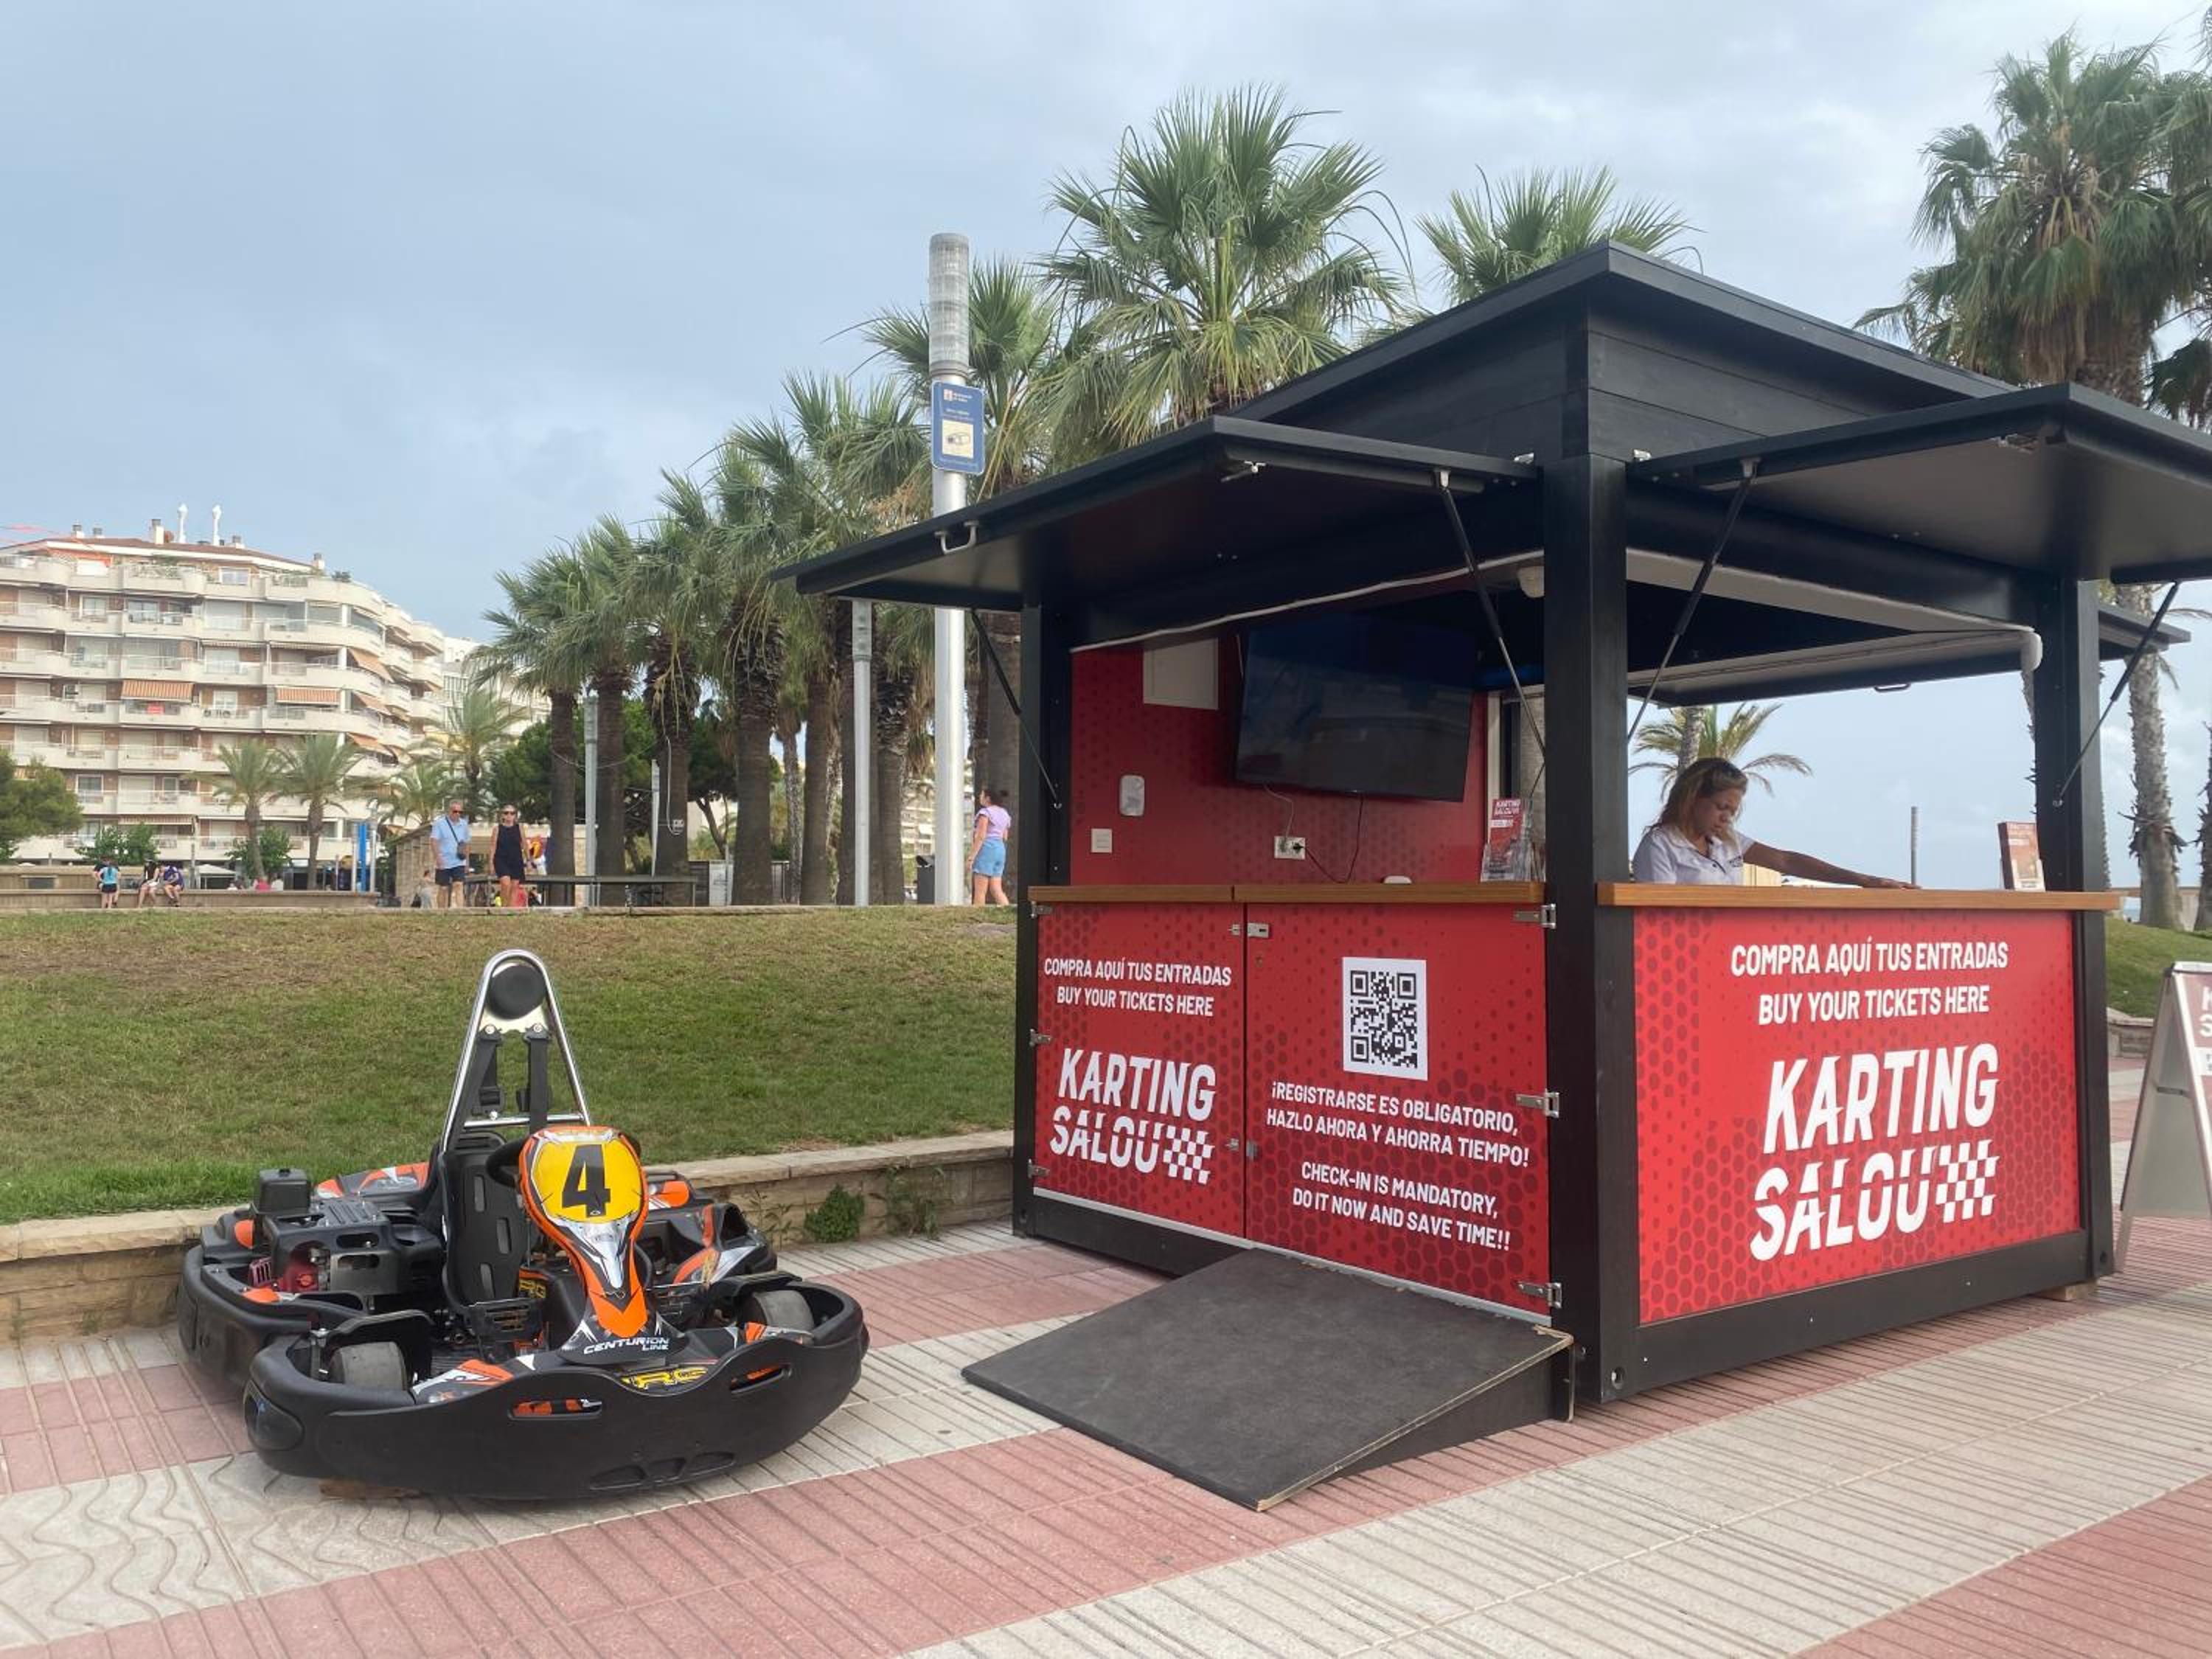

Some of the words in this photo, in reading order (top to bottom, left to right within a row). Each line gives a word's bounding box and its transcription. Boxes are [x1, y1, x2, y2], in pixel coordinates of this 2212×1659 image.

[1044, 958, 1092, 978] COMPRA
[1095, 957, 1125, 981] AQUÍ
[1127, 961, 1152, 982] TUS
[1155, 963, 1232, 987] ENTRADAS
[1731, 943, 1821, 977] COMPRA
[1824, 936, 1872, 977] AQUÍ
[1875, 942, 1912, 972] TUS
[1915, 941, 2008, 971] ENTRADAS
[1057, 986, 1082, 1005] BUY
[1084, 987, 1117, 1008] YOUR
[1119, 990, 1175, 1013] TICKETS
[1176, 995, 1214, 1017] HERE
[1759, 992, 1803, 1026] BUY
[1807, 990, 1860, 1022] YOUR
[1864, 987, 1941, 1018] TICKETS
[1944, 984, 1990, 1014] HERE
[1058, 1048, 1216, 1121] KARTING
[1272, 1081, 1377, 1115] ¡REGISTRARSE
[1378, 1095, 1400, 1116] ES
[1402, 1099, 1518, 1136] OBLIGATORIO,
[1763, 1043, 2000, 1154] KARTING
[1049, 1105, 1165, 1174] SALOU
[1266, 1108, 1313, 1133] HAZLO
[1315, 1116, 1368, 1141] AHORA
[1371, 1123, 1382, 1143] Y
[1384, 1126, 1453, 1155] AHORRA
[1458, 1136, 1529, 1168] TIEMPO!
[563, 1144, 611, 1217] 4
[1301, 1161, 1371, 1192] CHECK-IN
[1374, 1174, 1390, 1195] IS
[1391, 1178, 1499, 1220] MANDATORY,
[1750, 1145, 1937, 1261] SALOU
[1293, 1187, 1313, 1208] DO
[1315, 1192, 1329, 1211] IT
[1331, 1195, 1368, 1220] NOW
[1369, 1204, 1405, 1228] AND
[1406, 1211, 1453, 1239] SAVE
[1456, 1220, 1511, 1251] TIME!!
[583, 1337, 669, 1354] CENTURION
